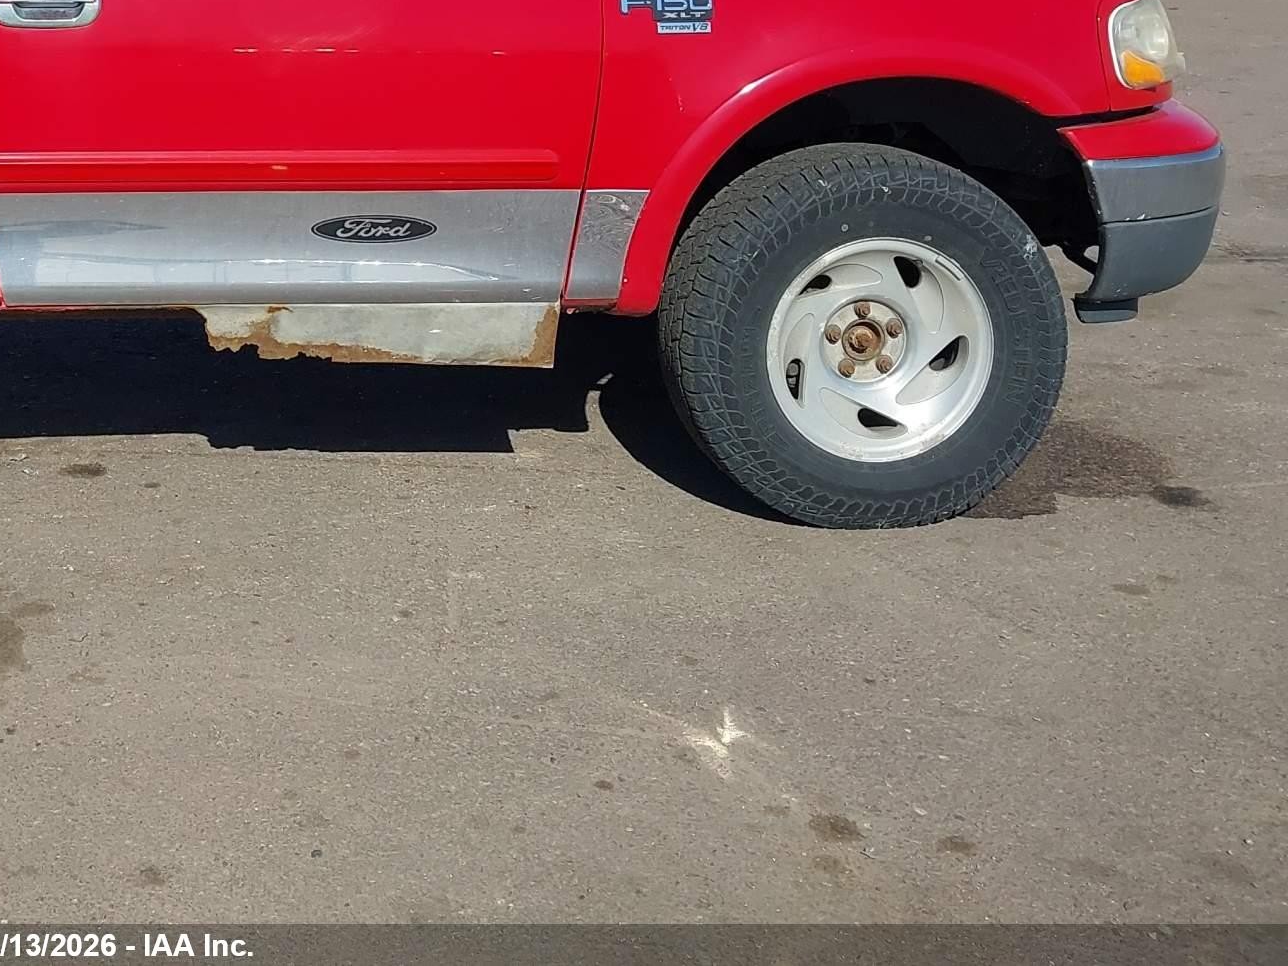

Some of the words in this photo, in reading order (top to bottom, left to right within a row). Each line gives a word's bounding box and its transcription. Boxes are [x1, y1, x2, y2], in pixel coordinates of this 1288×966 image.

[661, 11, 707, 20] XLT
[692, 23, 708, 31] V8
[336, 219, 412, 238] Ford
